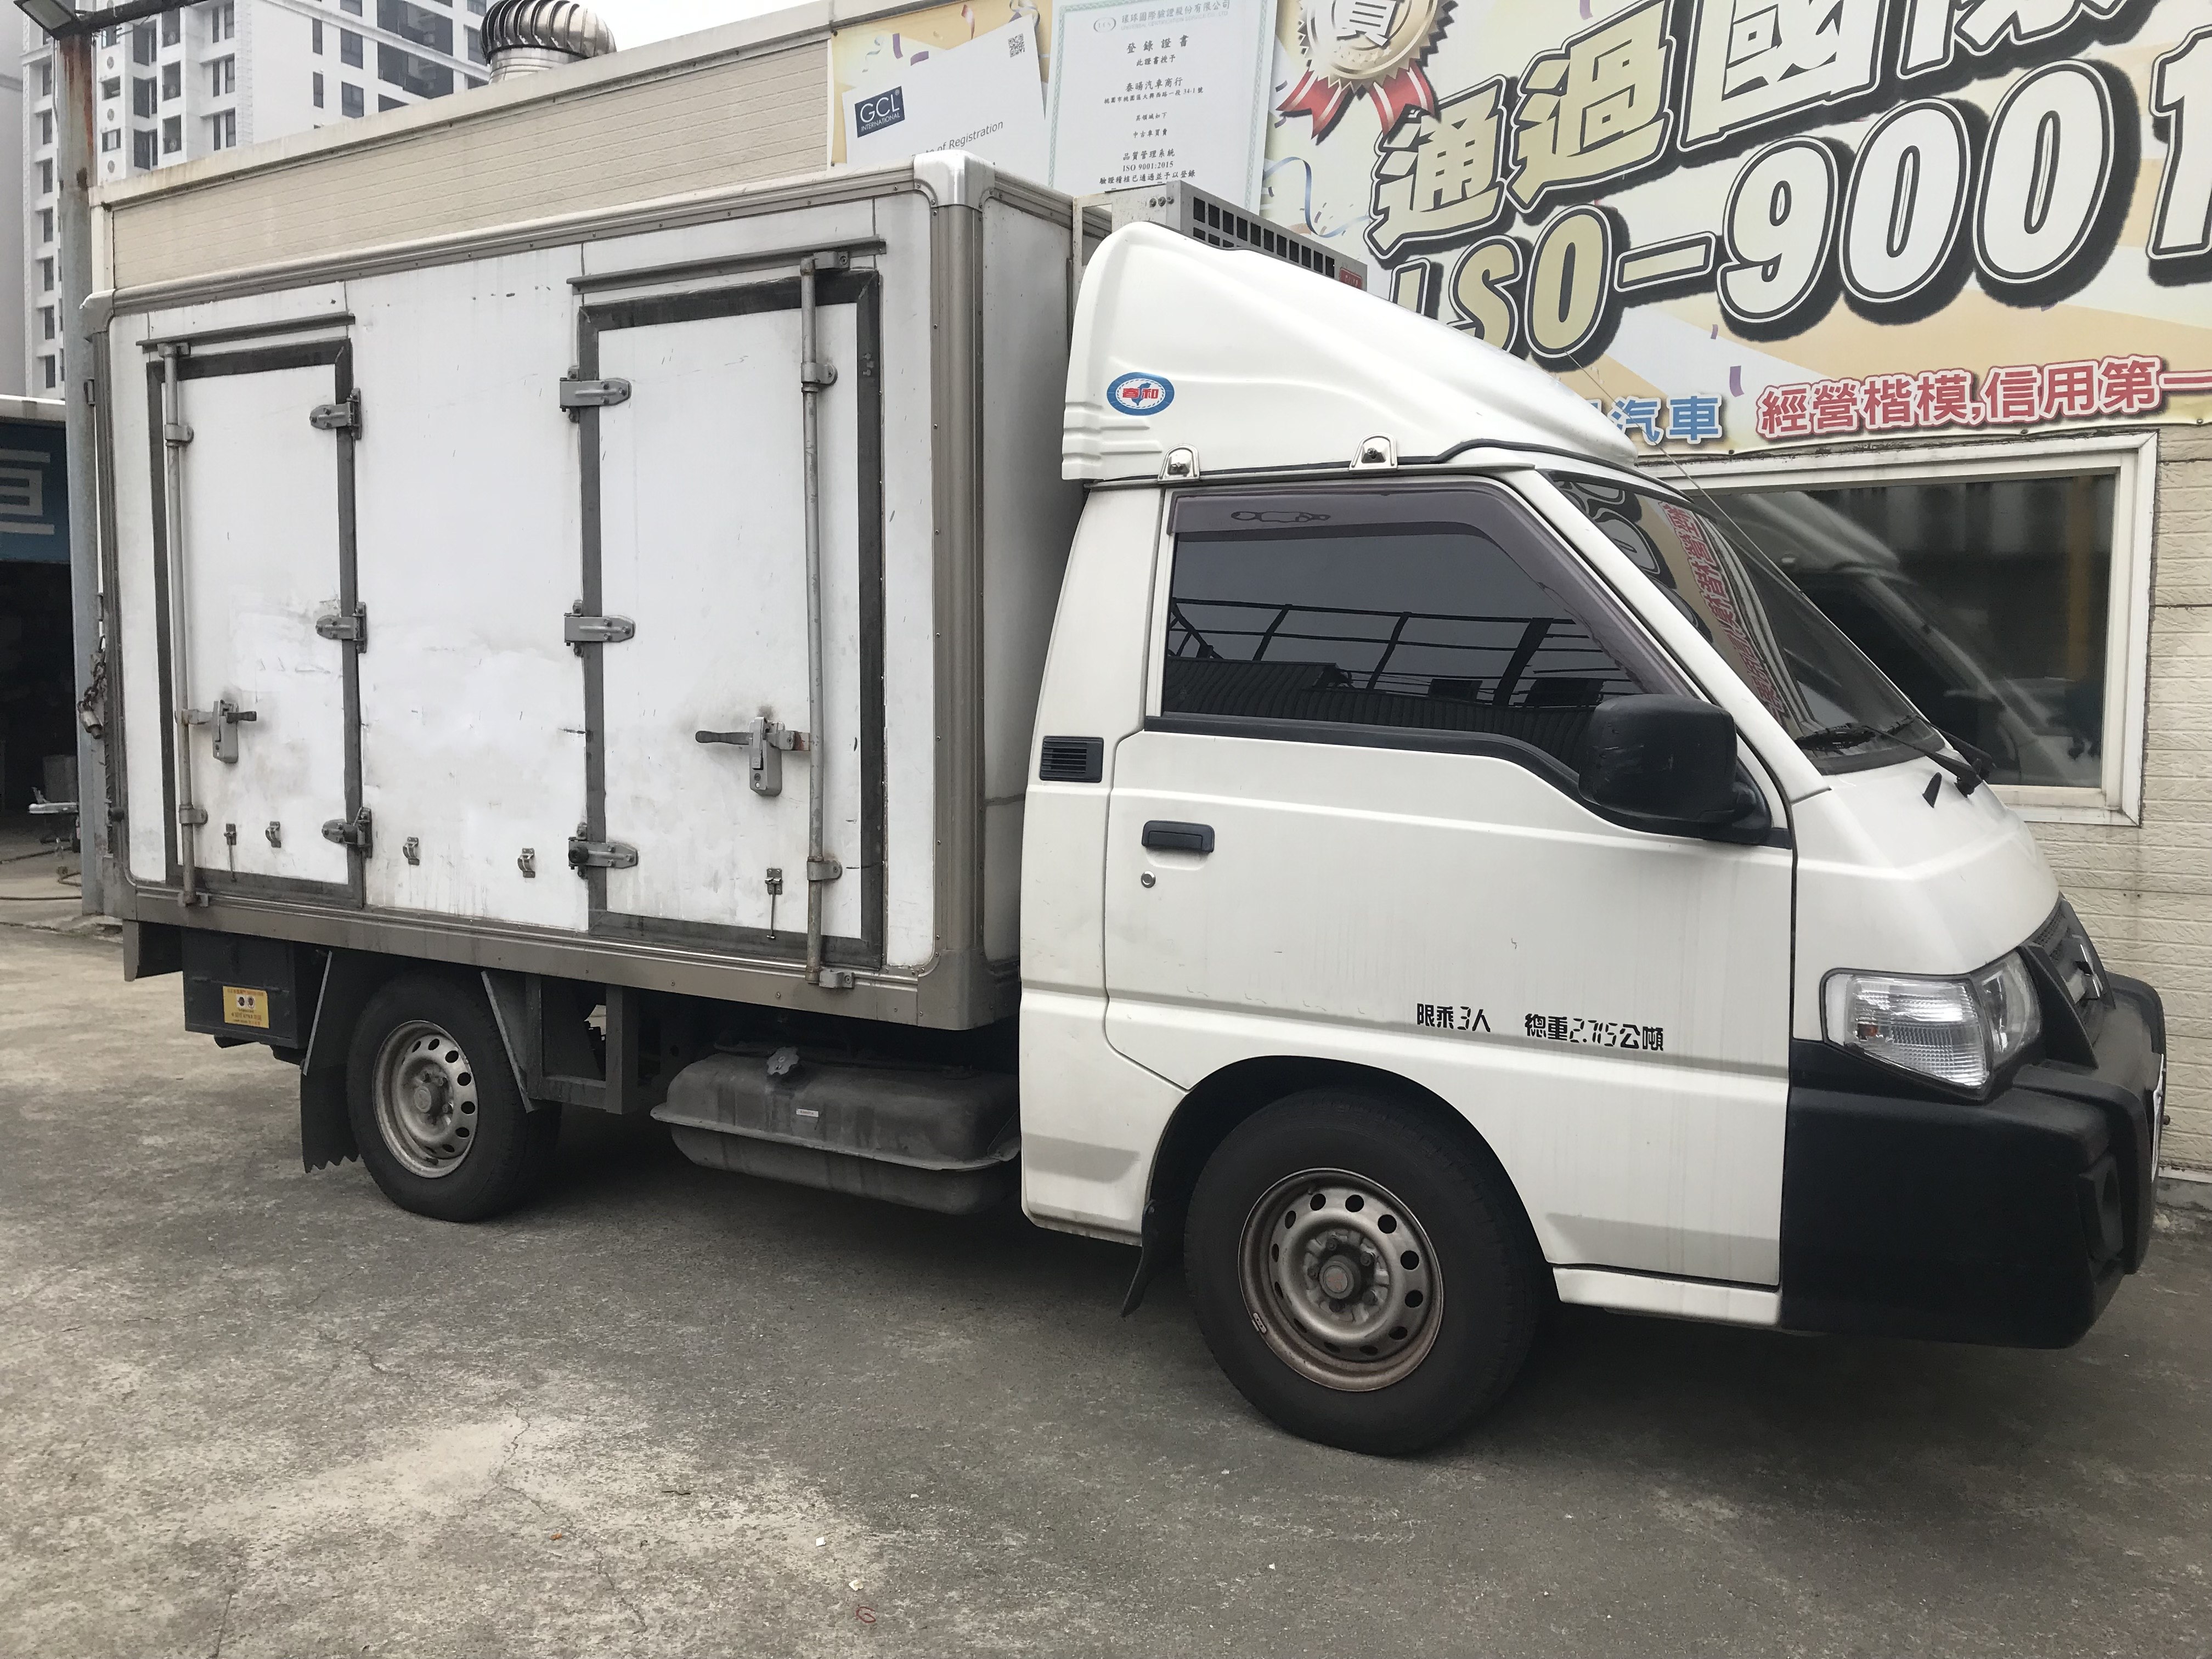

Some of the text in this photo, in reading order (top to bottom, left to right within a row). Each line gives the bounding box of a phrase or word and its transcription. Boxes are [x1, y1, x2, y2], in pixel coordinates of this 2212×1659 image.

[1126, 34, 1189, 54] 登錄證書
[1136, 54, 1176, 66] 此證書授予
[860, 94, 900, 123] GCL
[861, 112, 900, 132] INTERNATIONAL
[949, 121, 1003, 150] Registration
[1133, 128, 1167, 138] 中古車買賣
[1122, 148, 1175, 161] 品質管理系統
[1123, 161, 1173, 172] ISO 9001:2015
[1587, 393, 1722, 445] 汽車
[1417, 1003, 1491, 1032] 限乘3人
